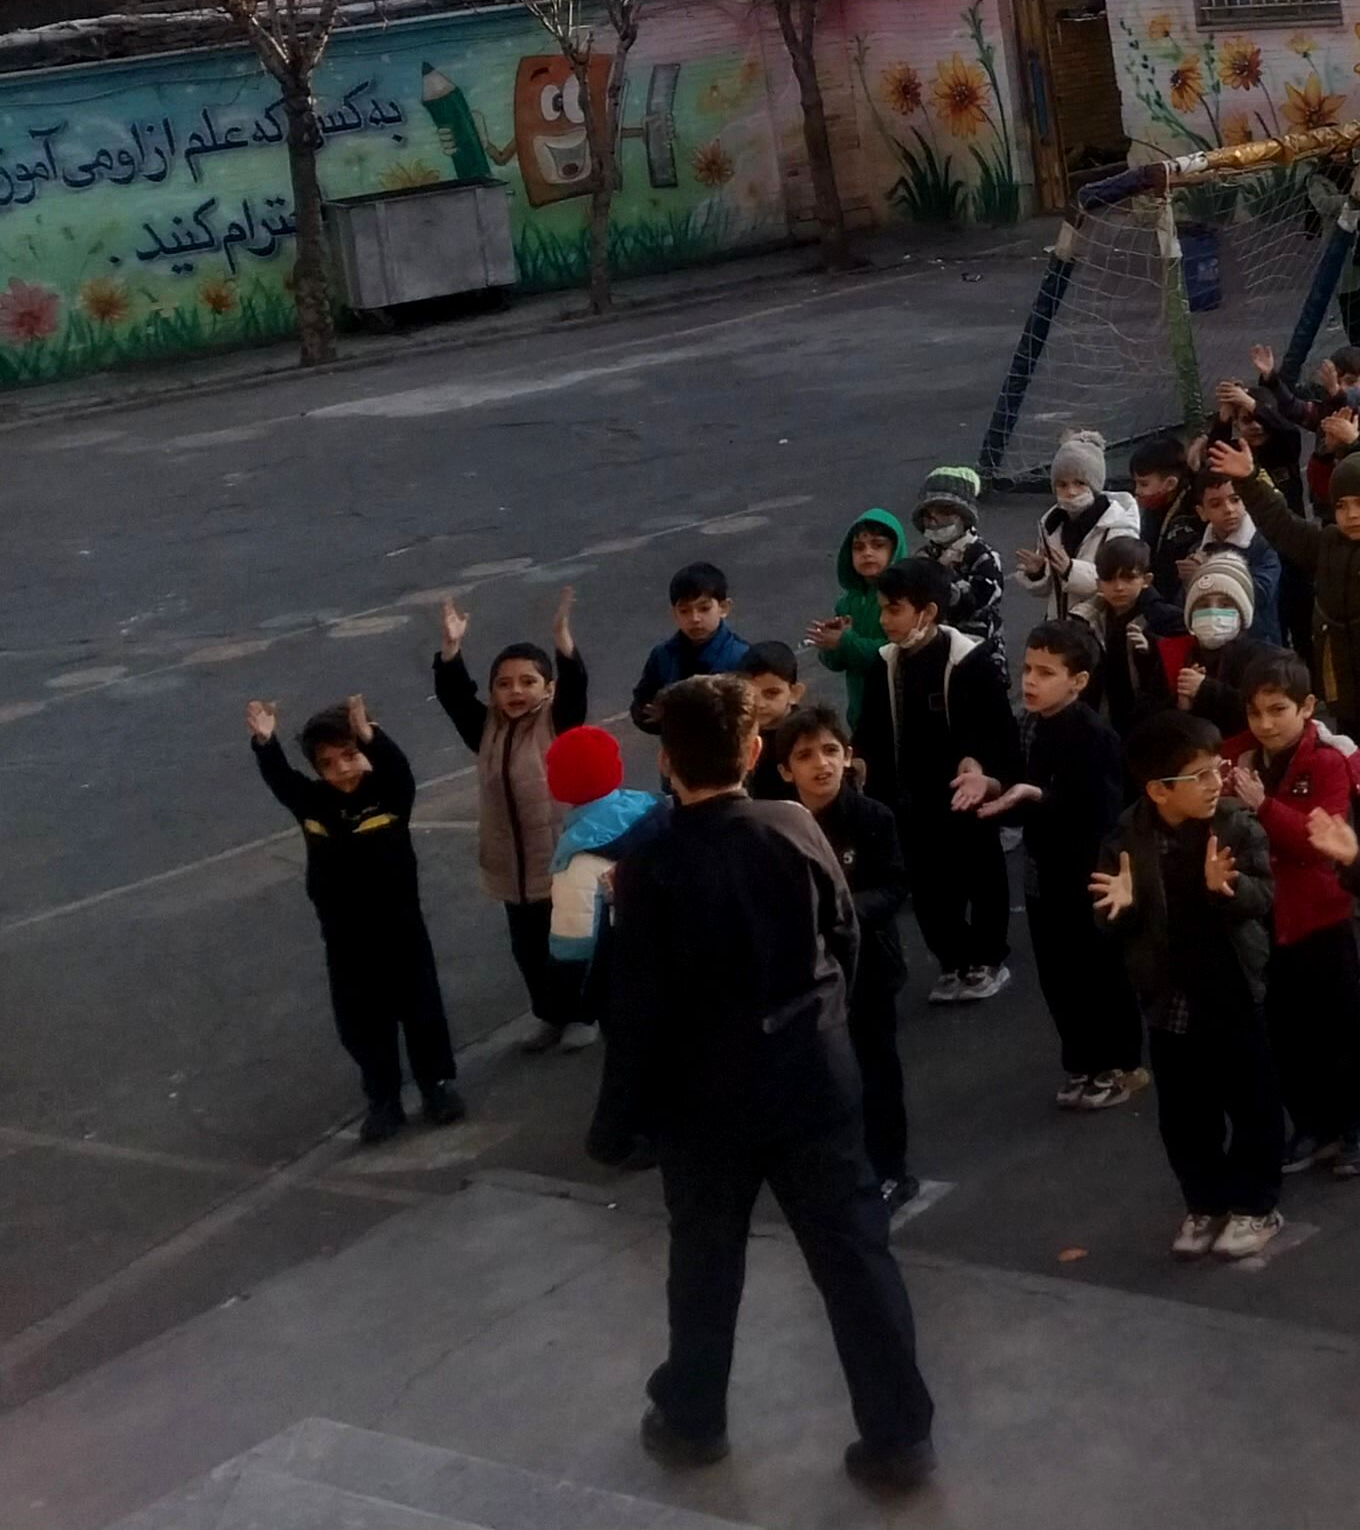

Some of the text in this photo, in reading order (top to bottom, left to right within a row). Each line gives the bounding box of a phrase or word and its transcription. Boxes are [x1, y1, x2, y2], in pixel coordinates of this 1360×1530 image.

[142, 117, 176, 183] از
[184, 107, 249, 184] علم
[251, 96, 287, 143] که
[368, 98, 403, 143] به
[62, 148, 114, 189] می
[109, 122, 146, 186] او
[223, 196, 297, 276] ترام
